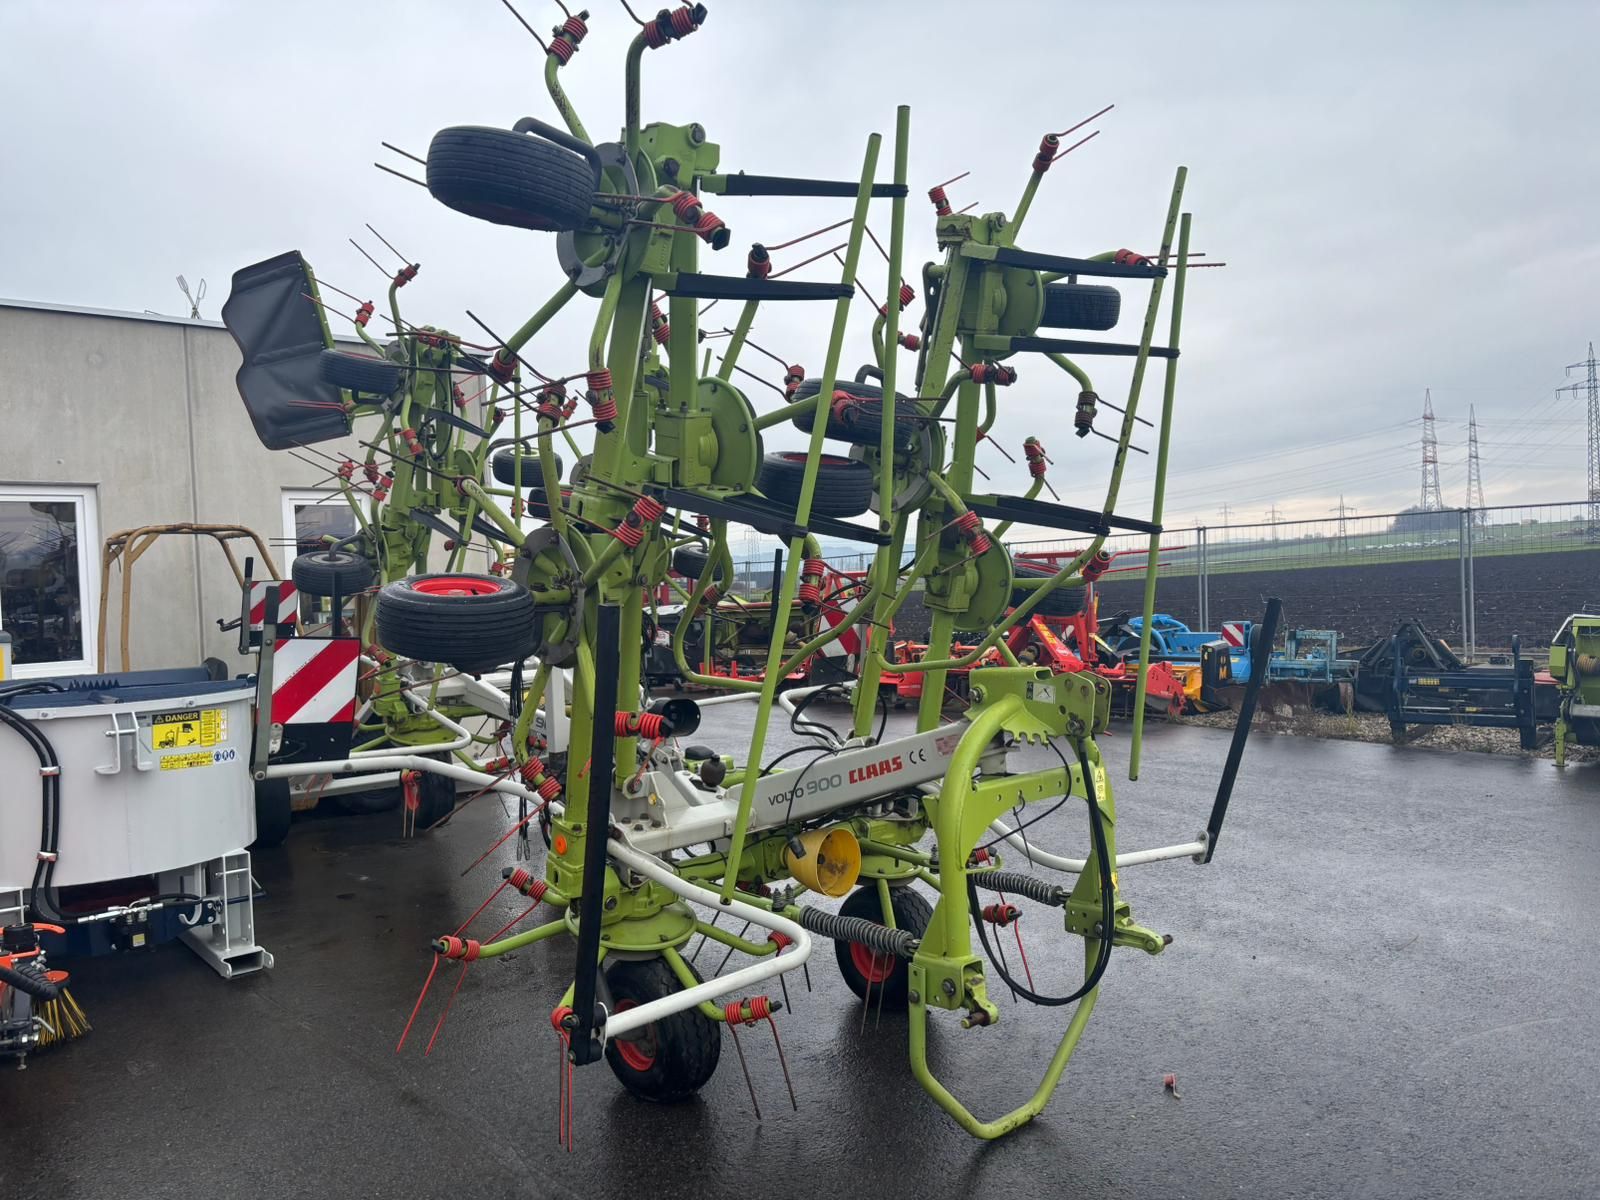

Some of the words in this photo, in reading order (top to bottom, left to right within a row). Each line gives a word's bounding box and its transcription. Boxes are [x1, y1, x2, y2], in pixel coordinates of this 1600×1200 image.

[165, 712, 199, 722] DANGER
[768, 786, 804, 806] VOLTO
[806, 774, 842, 796] 900
[848, 755, 903, 785] CLAAS
